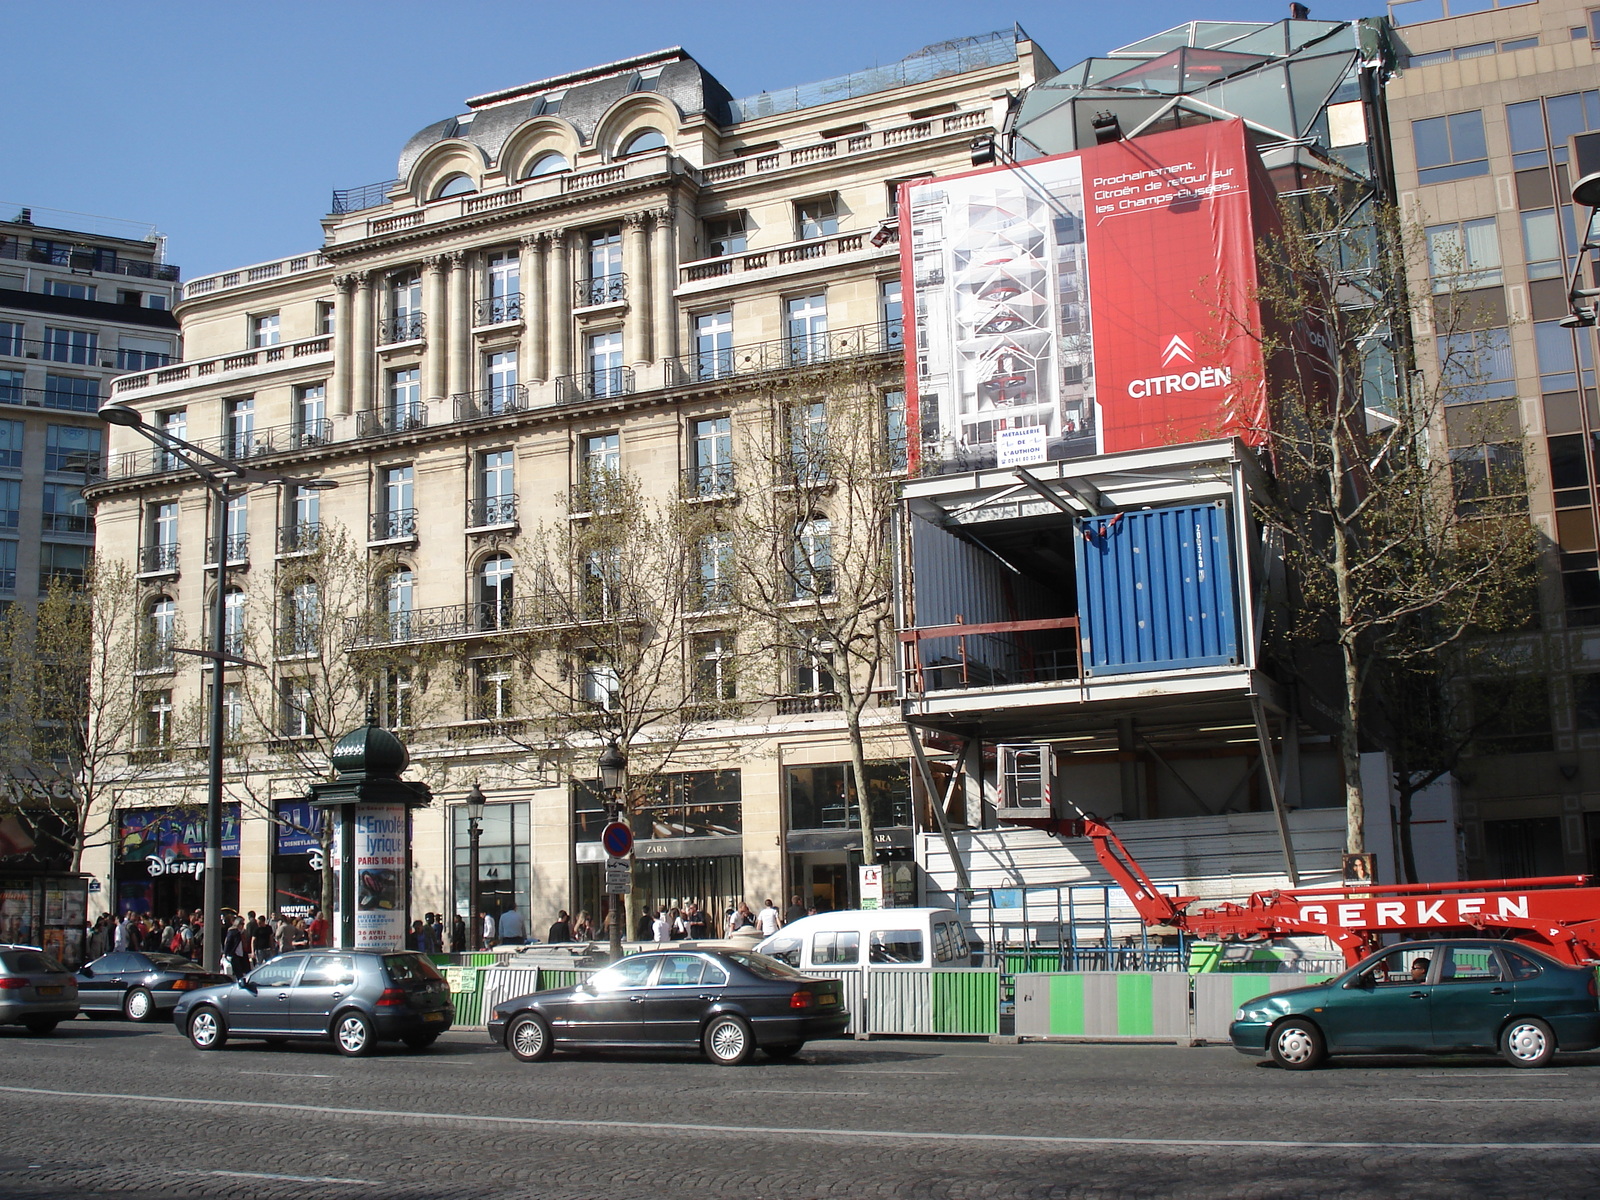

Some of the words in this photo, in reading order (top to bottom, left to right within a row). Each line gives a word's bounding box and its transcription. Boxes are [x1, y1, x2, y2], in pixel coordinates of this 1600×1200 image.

[1094, 184, 1140, 200] Citroën
[1144, 181, 1162, 191] de
[1166, 173, 1207, 187] retour
[1212, 168, 1234, 179] sur
[1095, 203, 1115, 214] les
[1128, 366, 1232, 398] CITROËN
[1002, 428, 1040, 437] METALLERIE
[874, 834, 892, 843] ARA
[366, 834, 402, 856] lyrique
[646, 845, 668, 854] ZARA
[357, 856, 379, 865] PARIS
[486, 868, 499, 878] 44
[1300, 895, 1530, 927] GERKEN
